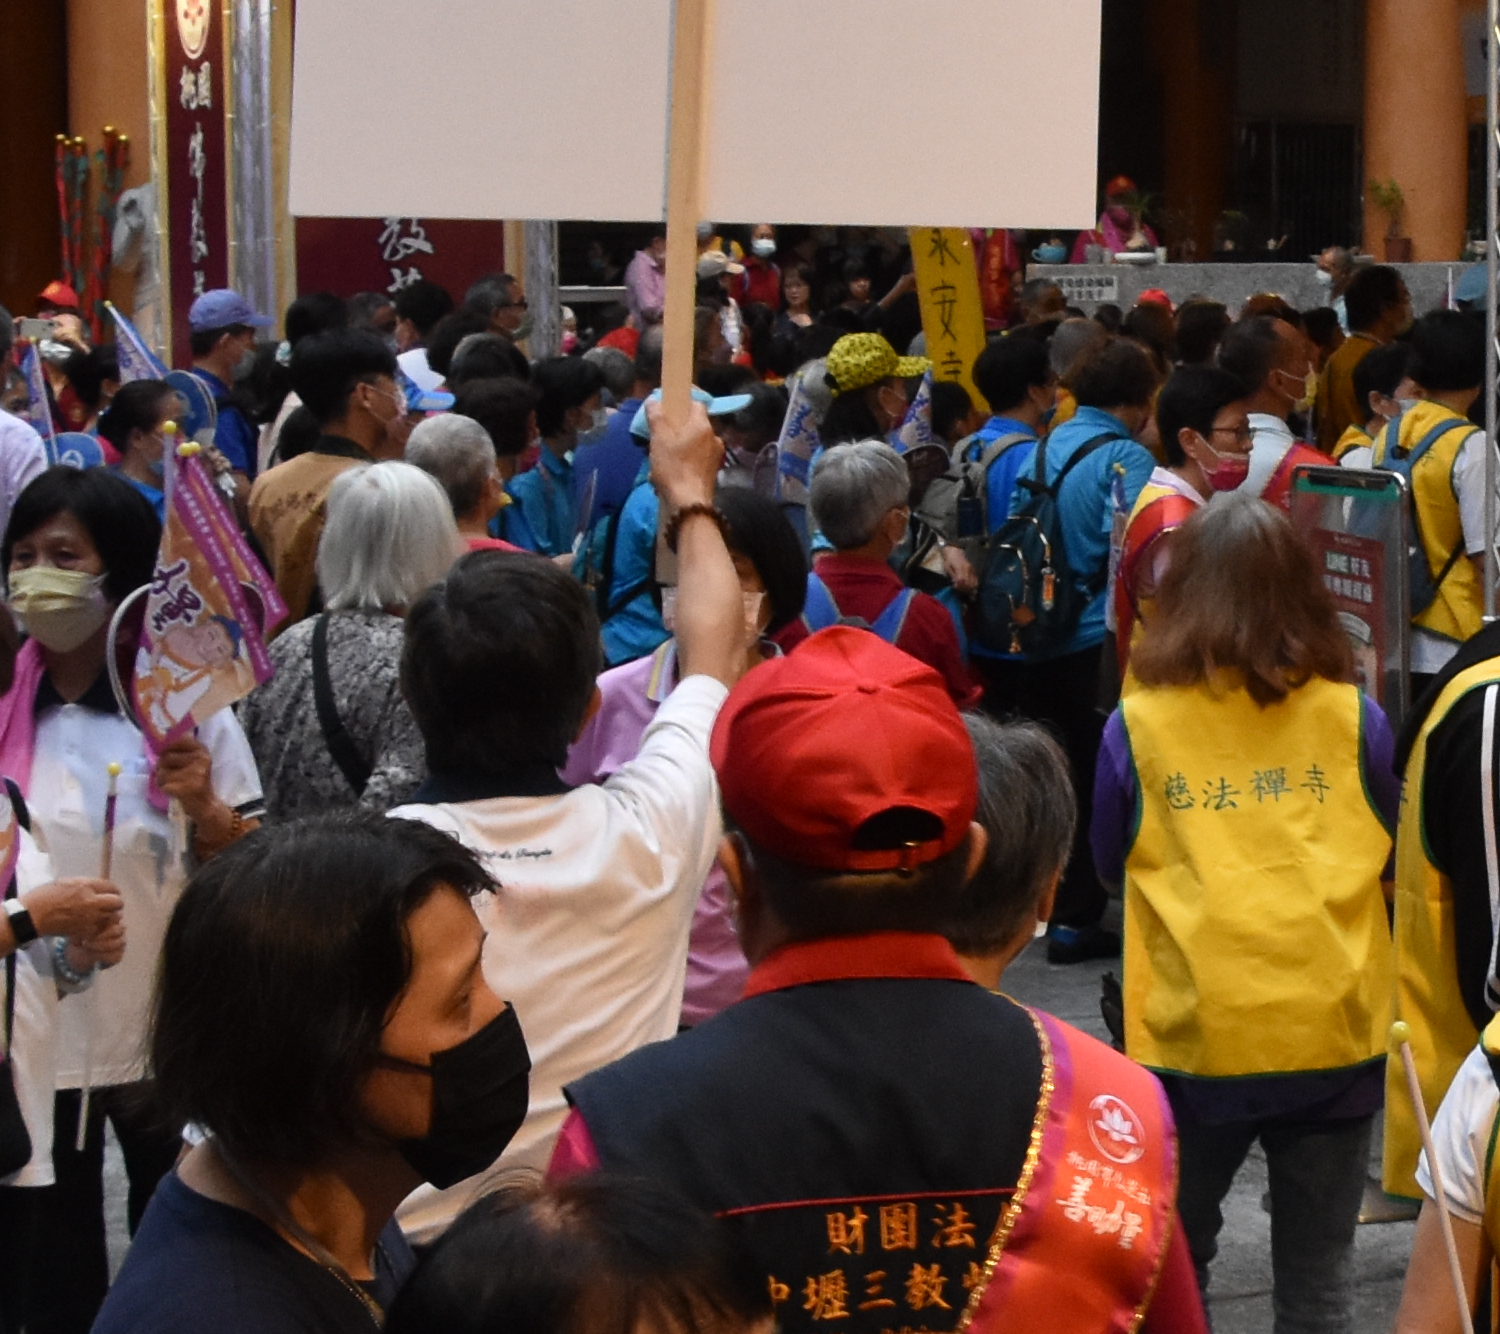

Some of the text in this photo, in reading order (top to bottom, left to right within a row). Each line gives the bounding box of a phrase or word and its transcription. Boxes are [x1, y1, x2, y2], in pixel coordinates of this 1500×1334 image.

[1163, 763, 1331, 812] 慈法禪寺
[1056, 1175, 1145, 1249] 善的力量
